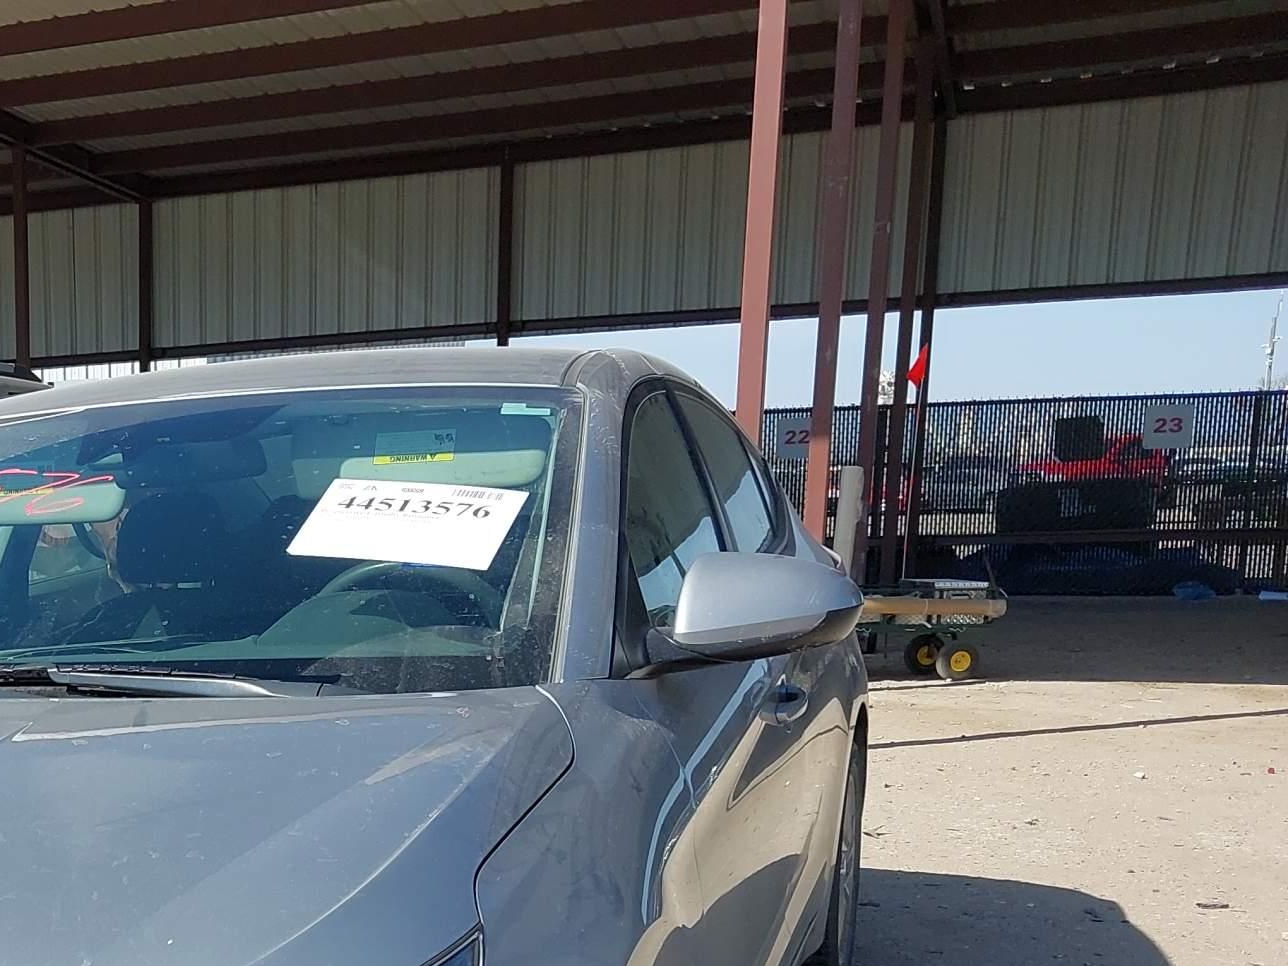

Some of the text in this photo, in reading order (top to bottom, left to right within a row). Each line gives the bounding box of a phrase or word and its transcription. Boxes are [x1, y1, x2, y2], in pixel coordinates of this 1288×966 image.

[1153, 417, 1183, 433] 23
[784, 430, 810, 445] 22
[337, 496, 491, 519] 44513576
